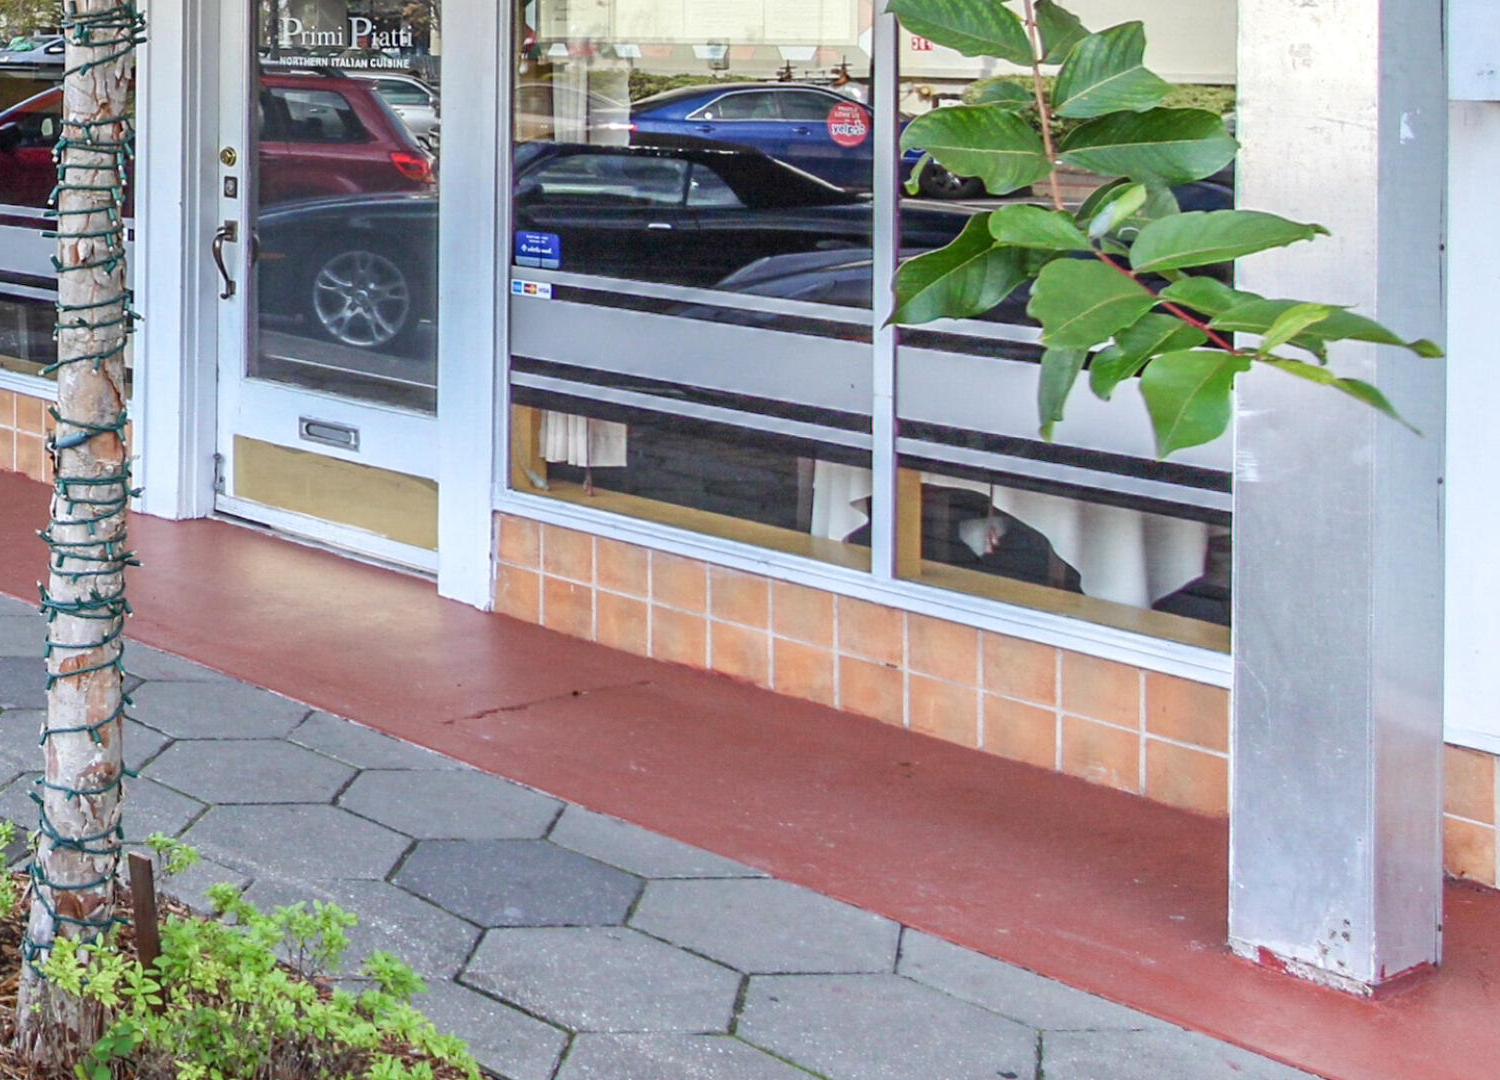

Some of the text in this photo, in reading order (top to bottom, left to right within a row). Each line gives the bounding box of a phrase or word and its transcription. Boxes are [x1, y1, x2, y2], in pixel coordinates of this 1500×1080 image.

[278, 16, 414, 50] Primi Piatti
[279, 56, 411, 69] NORTHERN ITALIAN CUISINE
